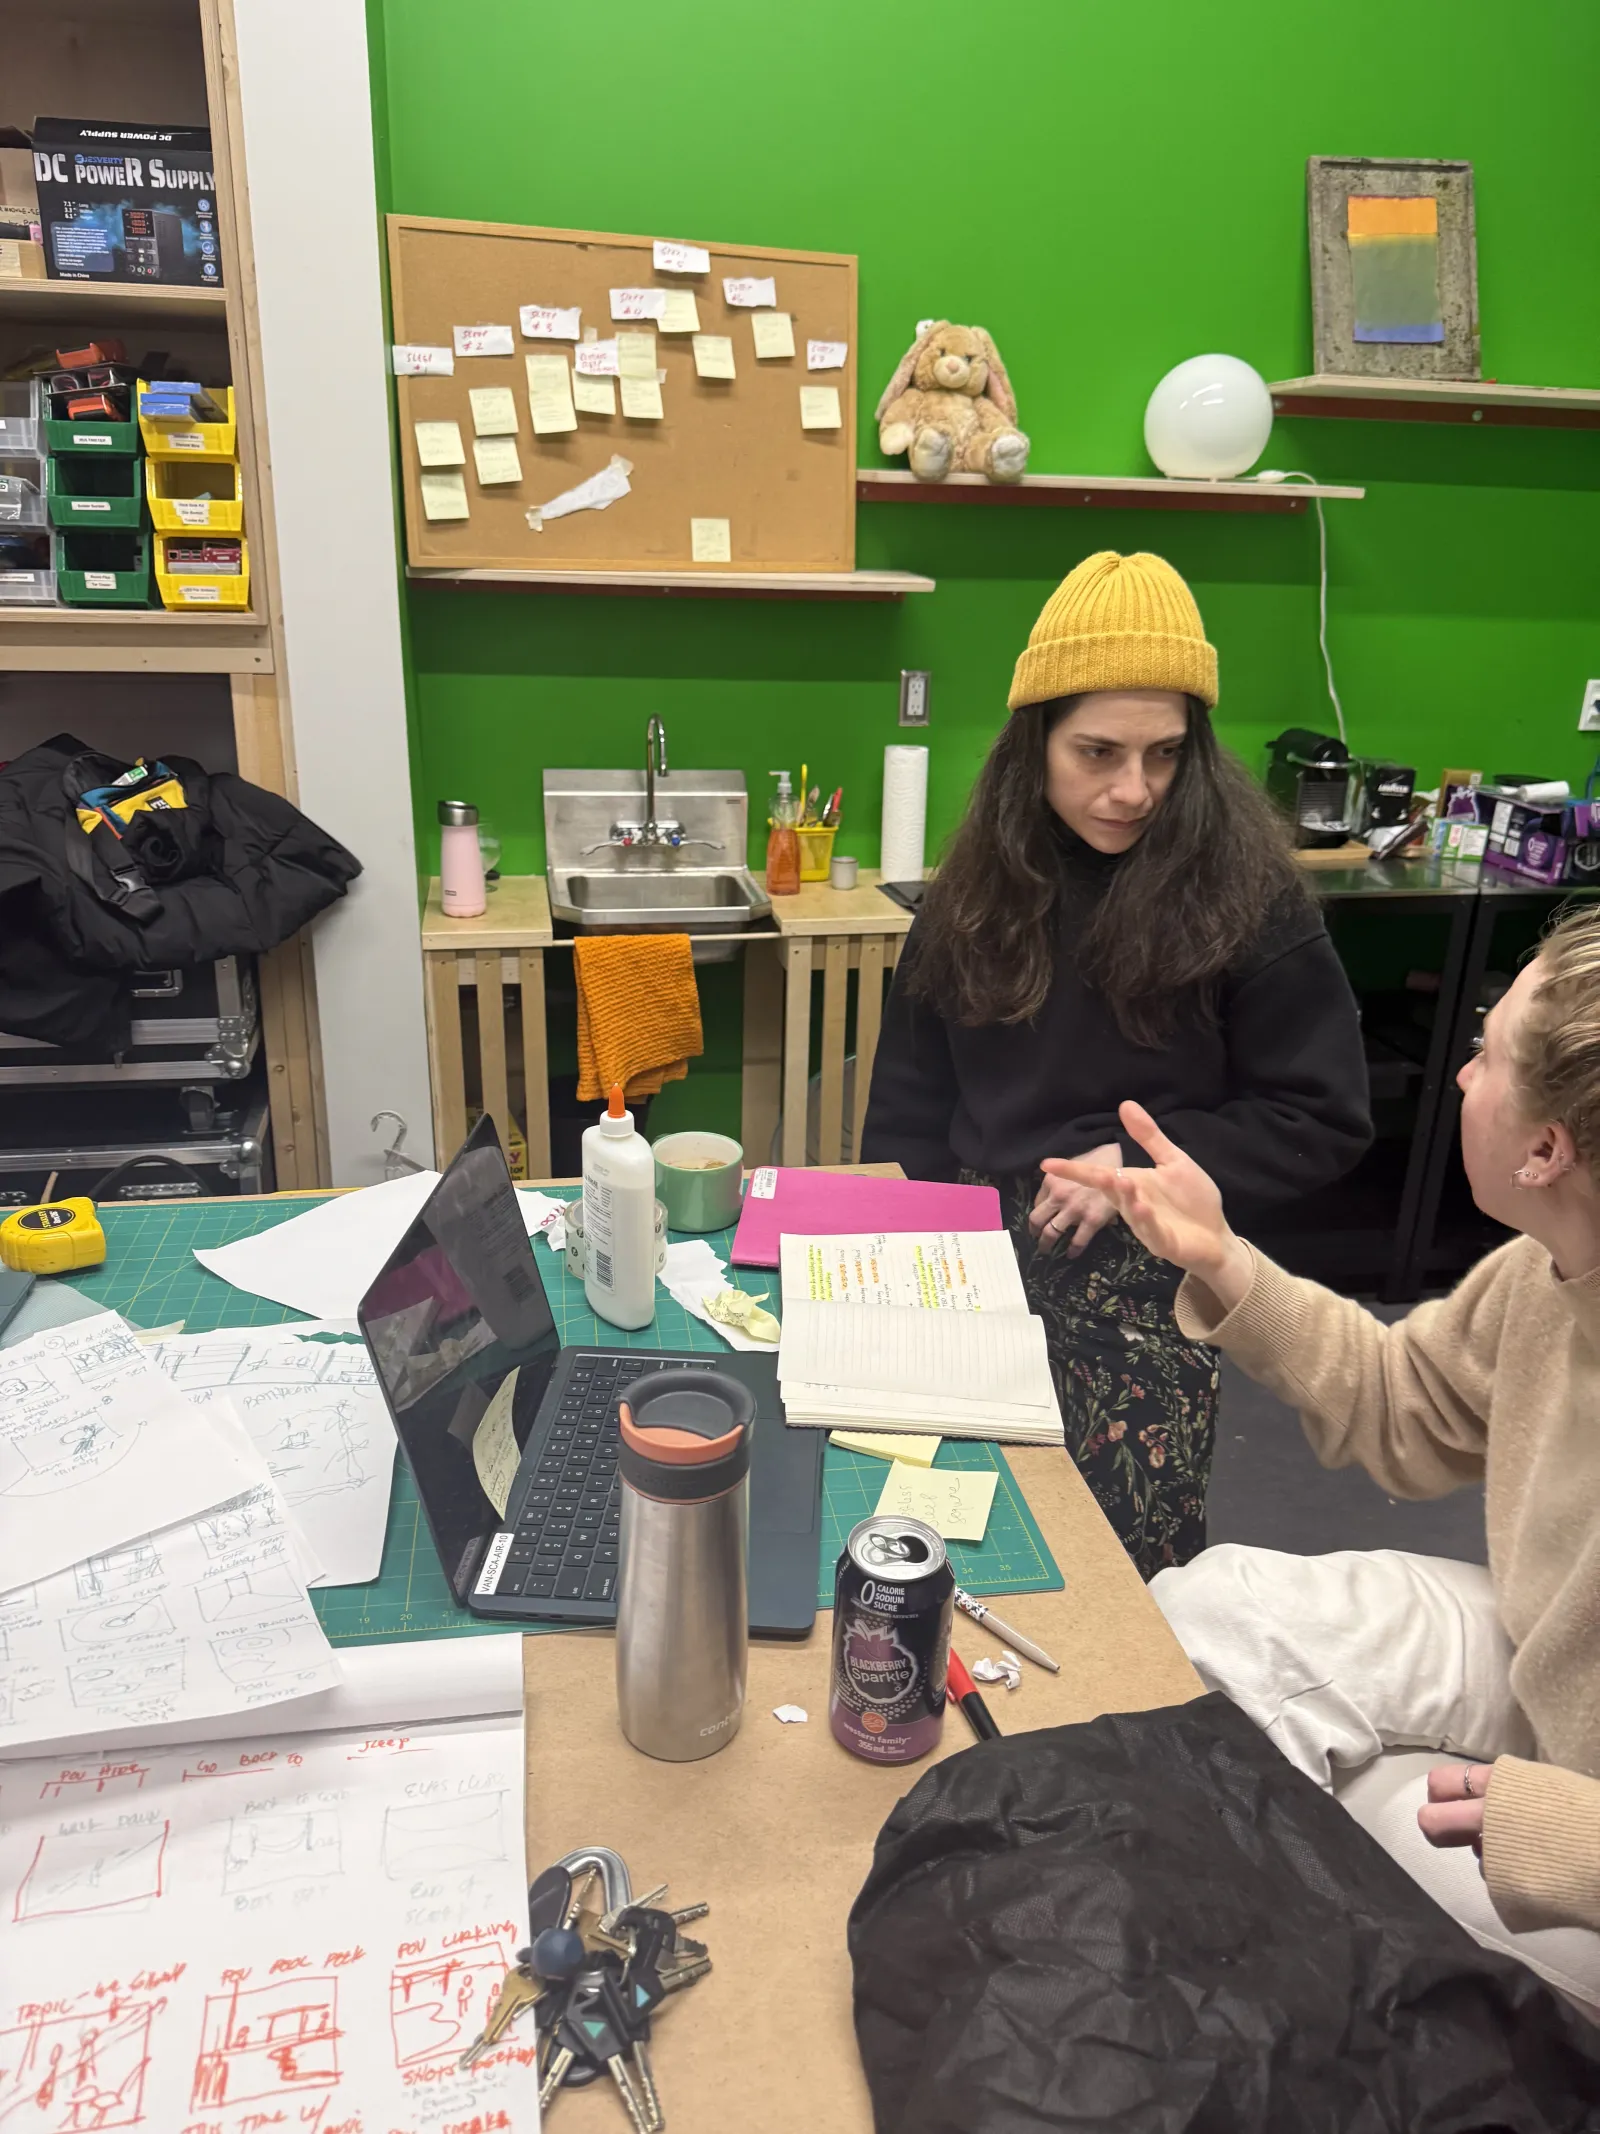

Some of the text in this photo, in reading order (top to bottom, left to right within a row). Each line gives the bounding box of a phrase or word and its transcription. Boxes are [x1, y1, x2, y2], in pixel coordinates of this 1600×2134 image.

[80, 129, 117, 138] SUPPLY
[121, 132, 157, 141] POWER
[33, 152, 216, 191] DC POWER SUPPLY
[480, 1534, 509, 1593] VAN-SCA-AIR-10
[861, 1580, 875, 1605] 0
[877, 1584, 905, 1596] CALORIE
[875, 1593, 905, 1604] SODIUM
[873, 1602, 898, 1612] SUCRE
[400, 1613, 413, 1621] 20
[849, 1655, 906, 1671] BLACKBERRY
[852, 1667, 910, 1683] Sparkle
[843, 1722, 907, 1745] western family
[398, 1937, 427, 1958] POV
